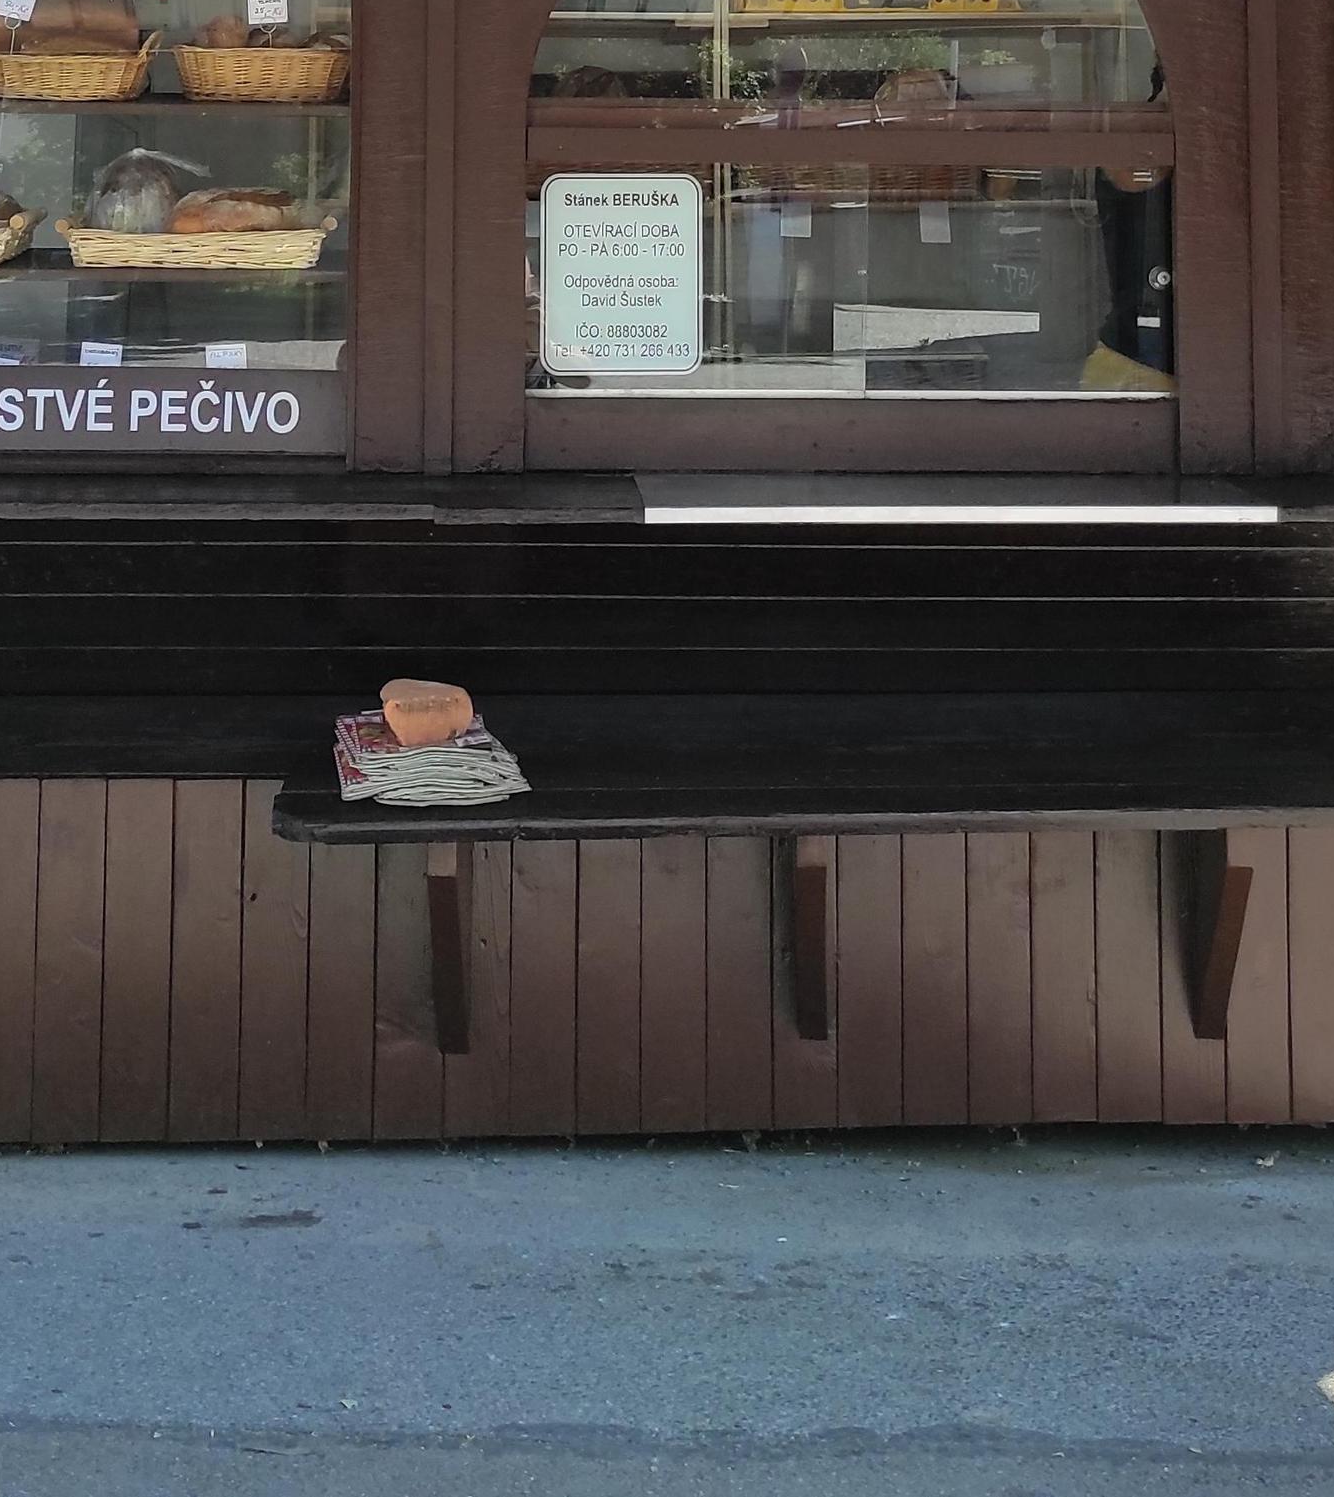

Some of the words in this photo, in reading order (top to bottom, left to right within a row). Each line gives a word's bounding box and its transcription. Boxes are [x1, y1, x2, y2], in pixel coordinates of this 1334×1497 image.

[564, 193, 609, 207] Stánek
[613, 190, 679, 207] BERUŠKA
[564, 221, 637, 238] OTEVÍRACÍ
[641, 224, 680, 238] DOBA
[558, 243, 578, 257] PO
[590, 240, 609, 257] PÁ
[612, 243, 639, 257] 6:00
[652, 243, 685, 257] 17:00
[564, 274, 634, 290] Odpovědná
[638, 274, 679, 288] osoba:
[581, 293, 616, 307] David
[619, 293, 662, 307] Šustek
[575, 322, 603, 338] IČO:
[579, 343, 611, 357] +420
[614, 343, 636, 357] 731
[667, 343, 690, 357] 433
[129, 380, 301, 434] PEČIVO
